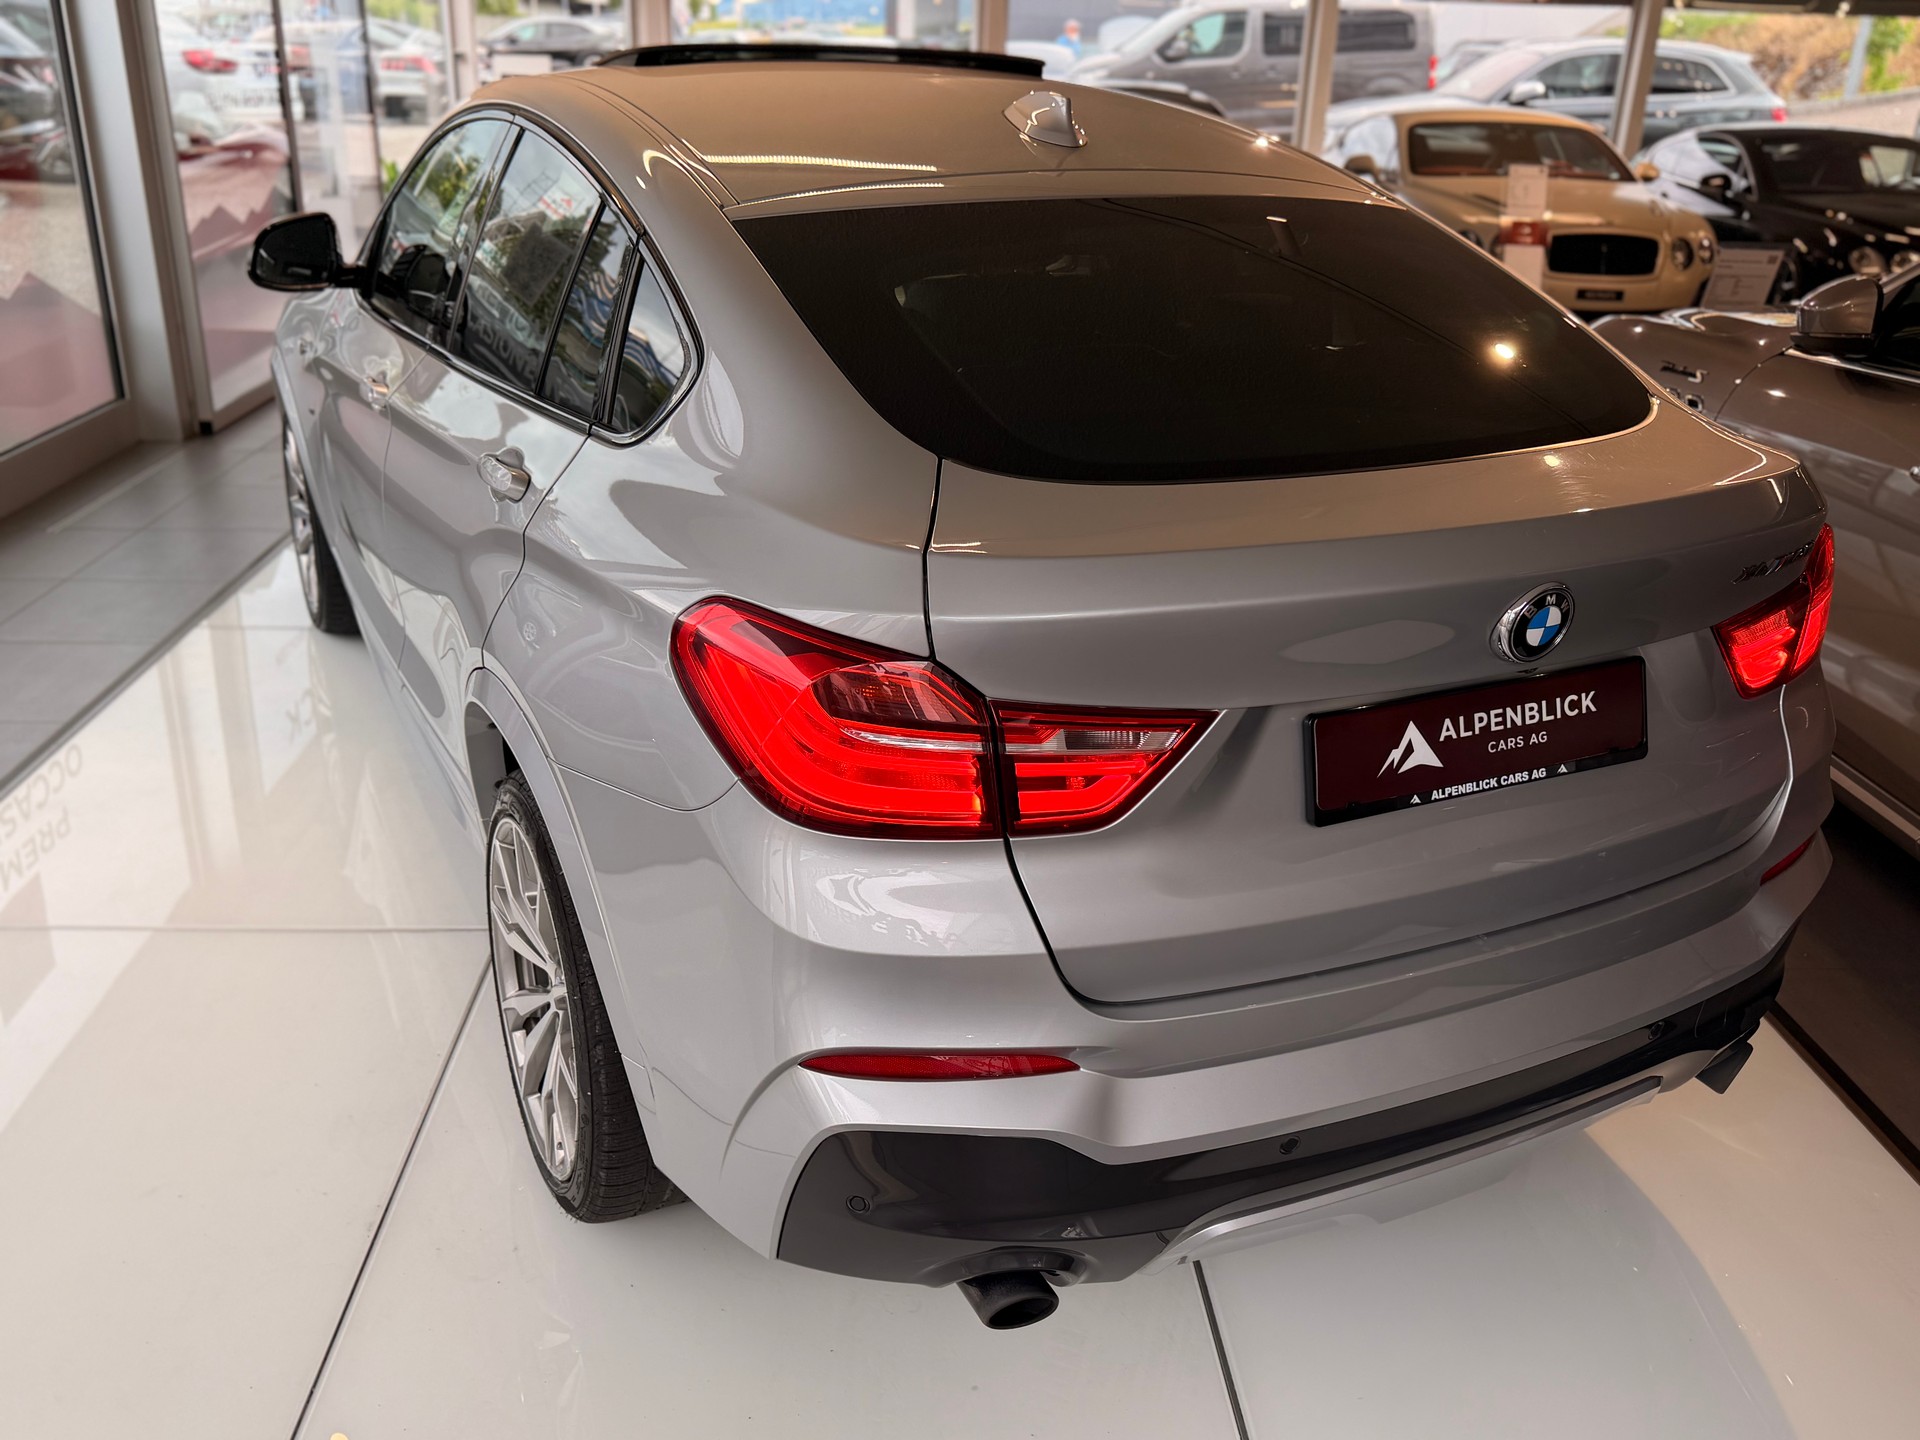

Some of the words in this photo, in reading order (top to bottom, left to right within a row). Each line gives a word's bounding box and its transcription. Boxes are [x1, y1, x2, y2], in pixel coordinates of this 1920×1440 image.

[1524, 594, 1570, 619] BMW
[1439, 691, 1597, 742] ALPENBLICK
[1488, 735, 1524, 754] CARS
[1530, 731, 1548, 745] AG
[1431, 777, 1498, 801] ALPENBLICK
[1500, 771, 1531, 786] CARS
[1532, 768, 1547, 780] AG
